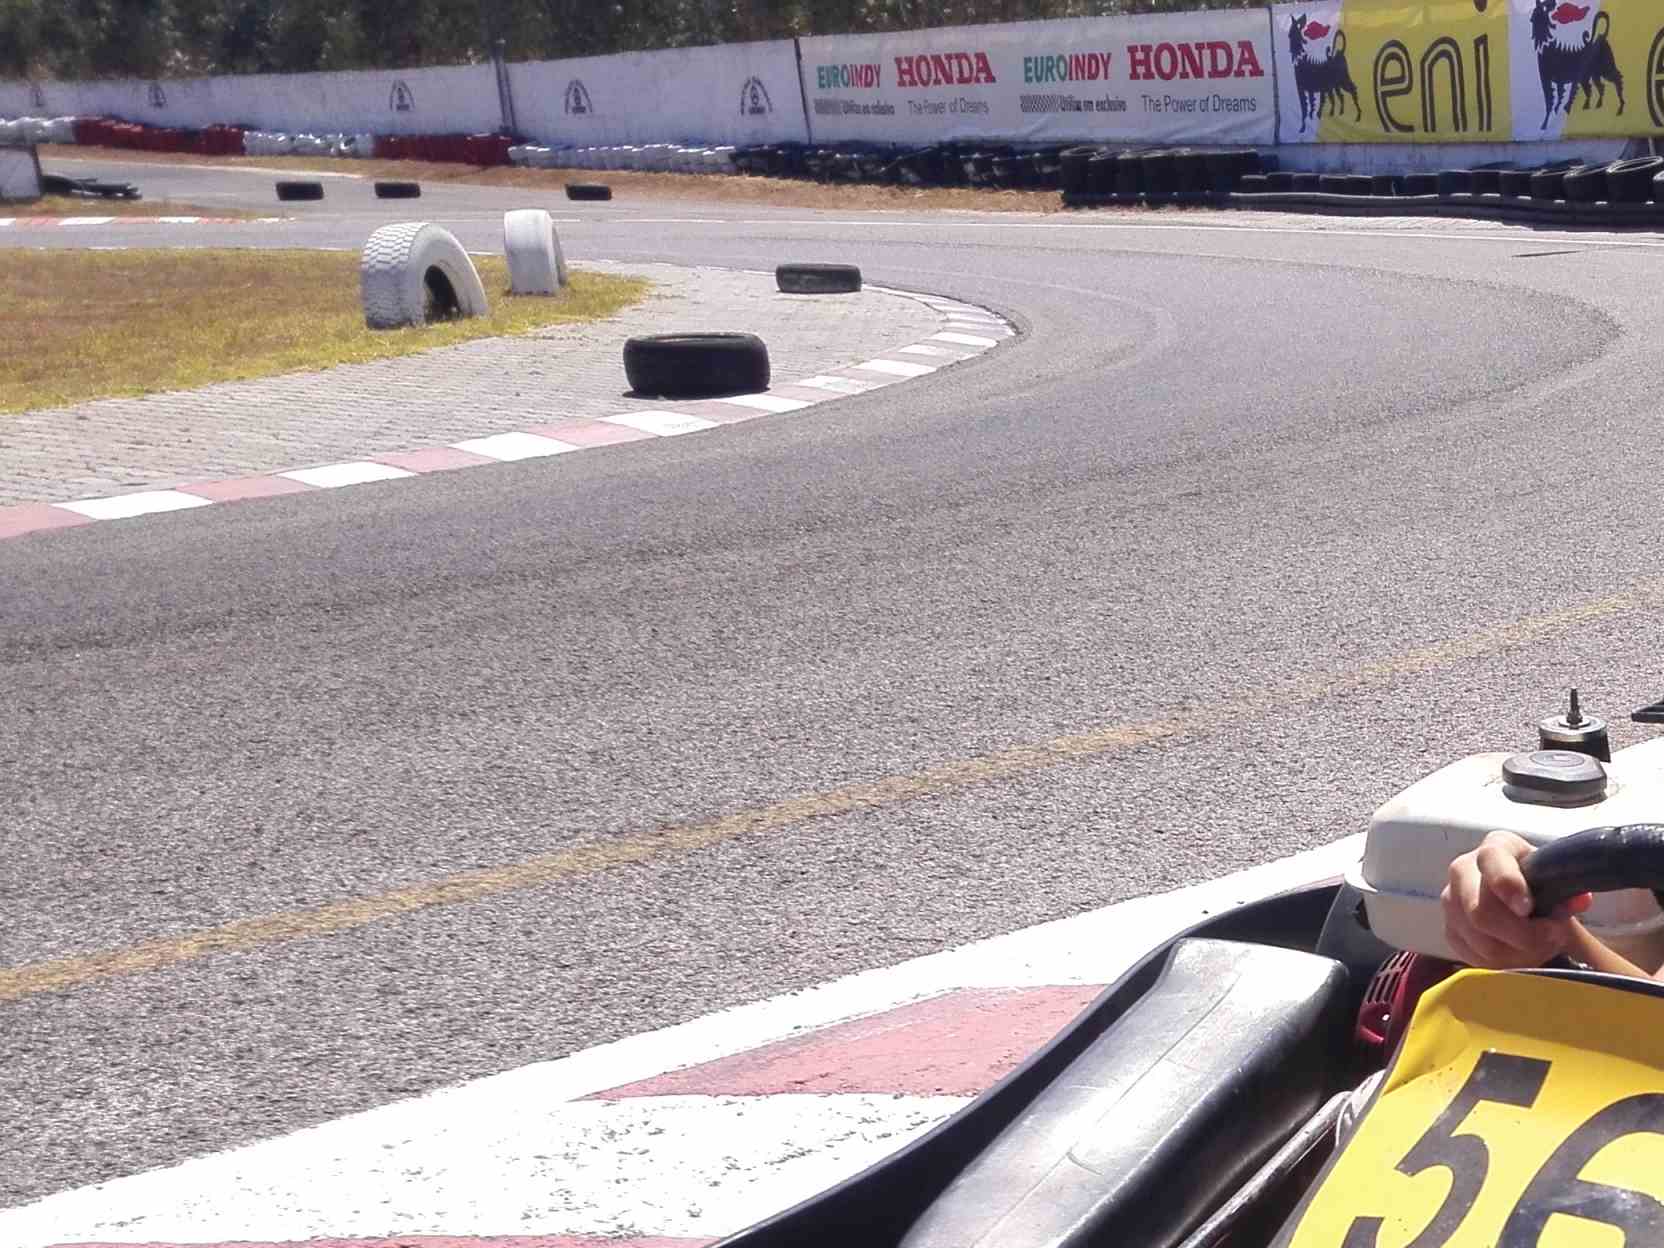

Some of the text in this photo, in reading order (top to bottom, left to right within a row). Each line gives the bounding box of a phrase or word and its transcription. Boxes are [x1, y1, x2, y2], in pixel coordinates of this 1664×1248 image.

[816, 63, 881, 89] EUROINDY
[894, 52, 997, 87] HONDA
[1023, 53, 1113, 83] EUROINDY
[1126, 40, 1265, 81] HONDA
[1373, 34, 1493, 133] eni
[1141, 94, 1257, 112] The Power of Dreams
